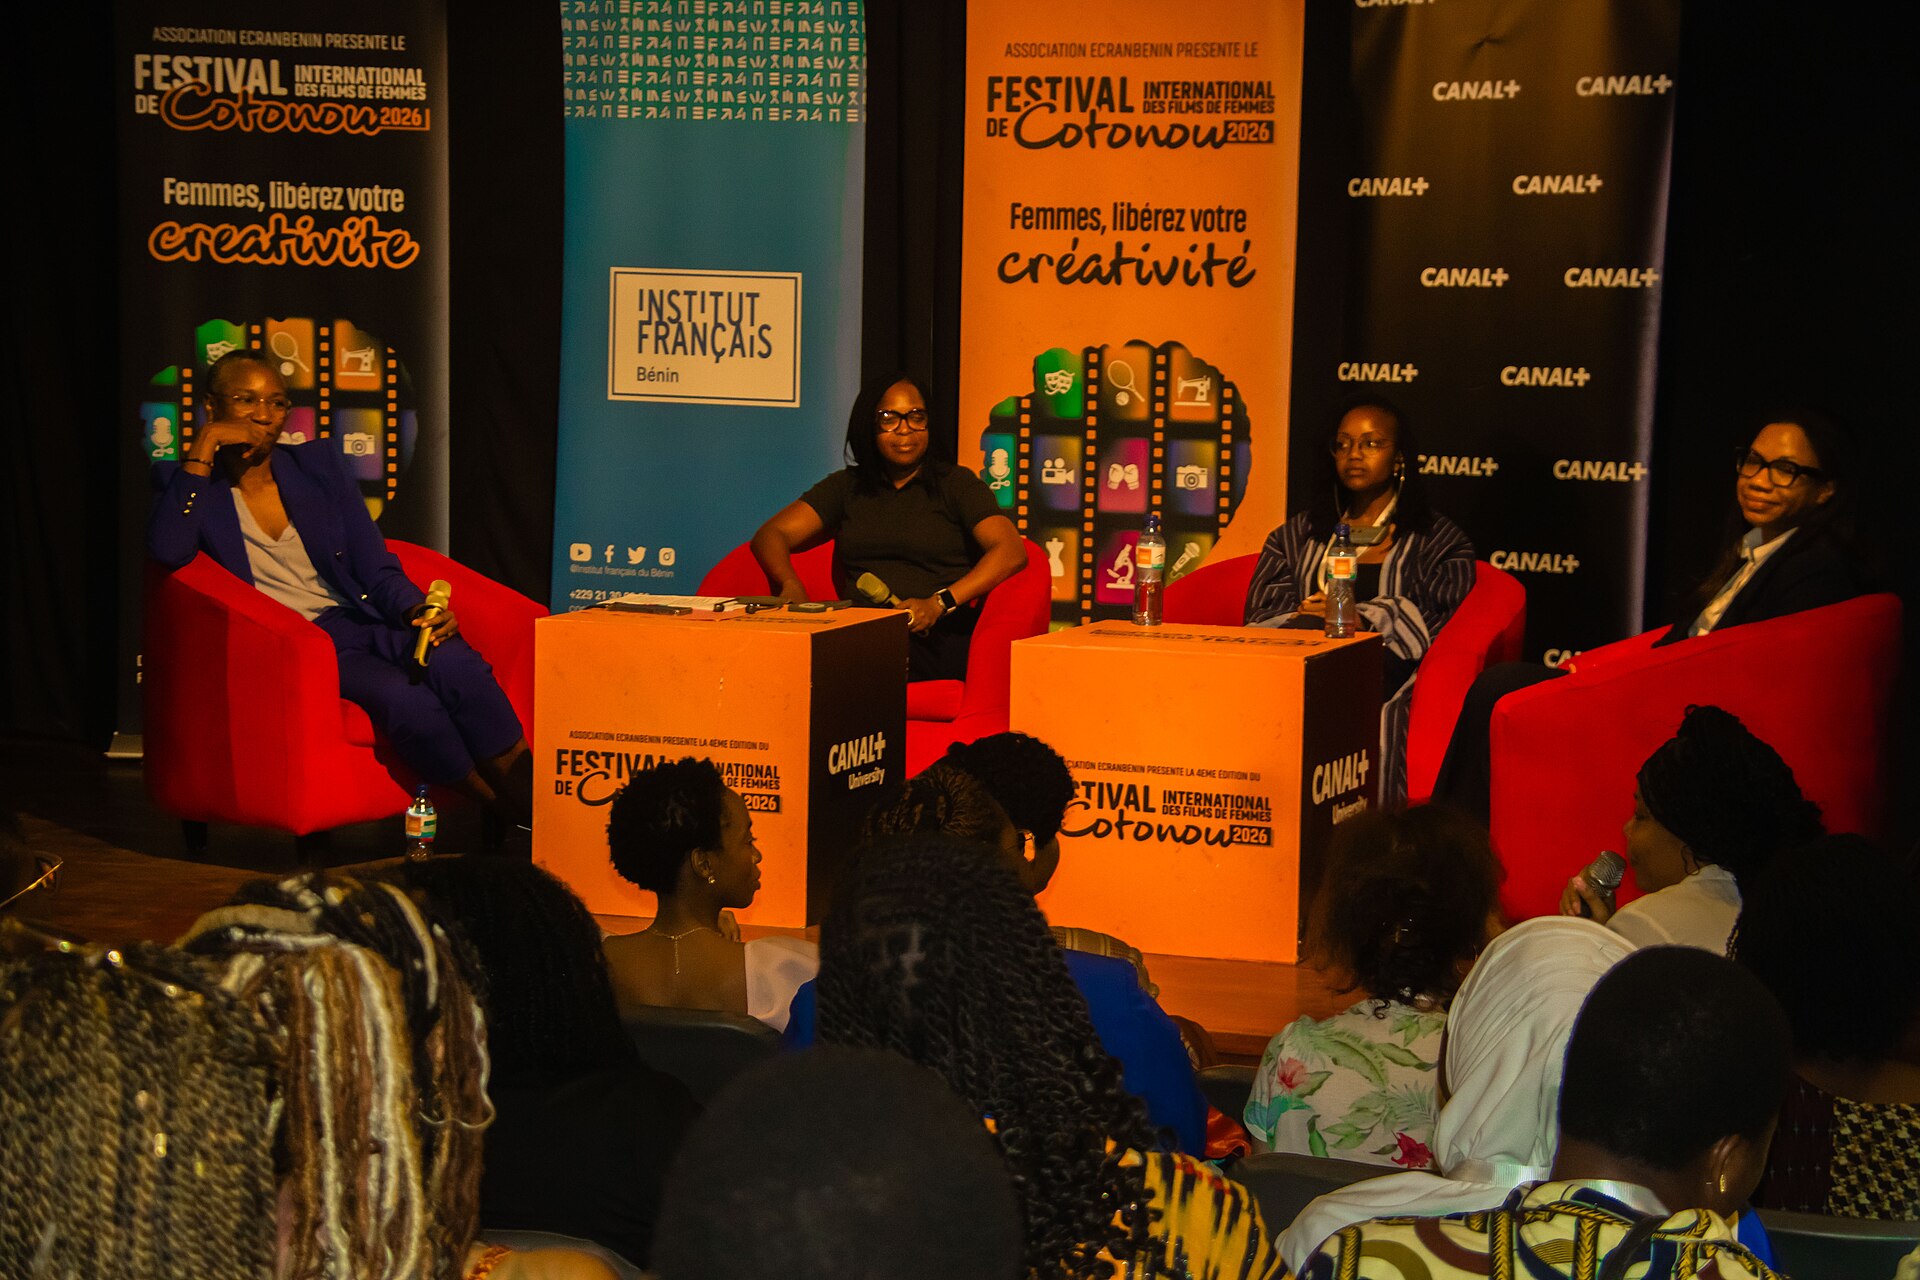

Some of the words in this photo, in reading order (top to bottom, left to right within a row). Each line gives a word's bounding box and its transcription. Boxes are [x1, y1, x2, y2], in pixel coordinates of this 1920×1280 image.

[152, 26, 237, 45] ASSOCIATION
[239, 30, 323, 48] ECRANBENIN
[325, 33, 389, 50] PRESENTE
[391, 35, 406, 51] LE
[1005, 42, 1087, 58] ASSOCIATION
[1090, 42, 1173, 58] ECRANBENIN
[1176, 42, 1241, 58] PRESENTE
[1244, 42, 1259, 57] LE
[134, 54, 289, 96] FESTIVAL
[294, 64, 426, 87] INTERNATIONAL
[1576, 74, 1673, 97] CANAL+
[294, 83, 318, 98] DES
[320, 84, 356, 98] FILMS
[357, 85, 374, 99] DE
[375, 86, 426, 101] FEMMES
[987, 75, 1135, 113] FESTIVAL
[1143, 80, 1275, 99] INTERNATIONAL
[1432, 79, 1521, 101] CANAL+
[134, 94, 159, 115] DE
[160, 78, 382, 136] Cotonou
[380, 106, 422, 127] 2026
[1142, 100, 1165, 114] DES
[1168, 101, 1204, 114] FILMS
[1206, 101, 1221, 114] DE
[1224, 101, 1275, 114] FEMMES
[986, 117, 1008, 137] DE
[1014, 101, 1228, 150] Cotonou
[1226, 121, 1271, 143] 2026
[163, 177, 265, 212] Femmes,
[269, 181, 344, 212] libérez
[346, 184, 405, 213] votre
[1347, 177, 1430, 198] CANAL+
[1512, 174, 1603, 196] CANAL+
[1010, 202, 1106, 235] Femmes,
[1112, 201, 1185, 232] libérez
[1190, 204, 1247, 233] votre
[998, 236, 1256, 288] créativité
[1420, 267, 1509, 287] CANAL+
[1564, 267, 1660, 288] CANAL+
[638, 288, 761, 328] INSTITUT
[636, 366, 680, 383] Bénin
[1338, 362, 1419, 383] CANAL+
[1500, 366, 1591, 387] CANAL+
[1553, 459, 1649, 482] CANAL+
[1490, 550, 1580, 574] CANAL+
[569, 589, 593, 600] +229
[595, 590, 606, 600] 21
[699, 738, 708, 747] LA
[828, 731, 887, 776] CANAL+
[556, 749, 665, 779] FESTIVA
[716, 762, 780, 779] NATIONAL
[1066, 760, 1096, 770] CIATION
[1147, 765, 1184, 777] PRESENTE
[1186, 767, 1195, 777] LA
[728, 777, 739, 788] DE
[741, 778, 780, 790] FEMMES
[848, 766, 886, 791] University
[1312, 748, 1370, 805] CANAL+
[555, 780, 573, 796] DE
[1073, 780, 1156, 814] TIVAL
[744, 794, 777, 811] 2026
[1163, 789, 1272, 811] INTERNATIONAL
[1162, 804, 1181, 816] DES
[1183, 805, 1213, 818] FILMS
[1214, 808, 1227, 819] DE
[1229, 810, 1272, 822] FEMMES
[1060, 801, 1233, 848] Cotonou
[1231, 826, 1270, 845] 2026
